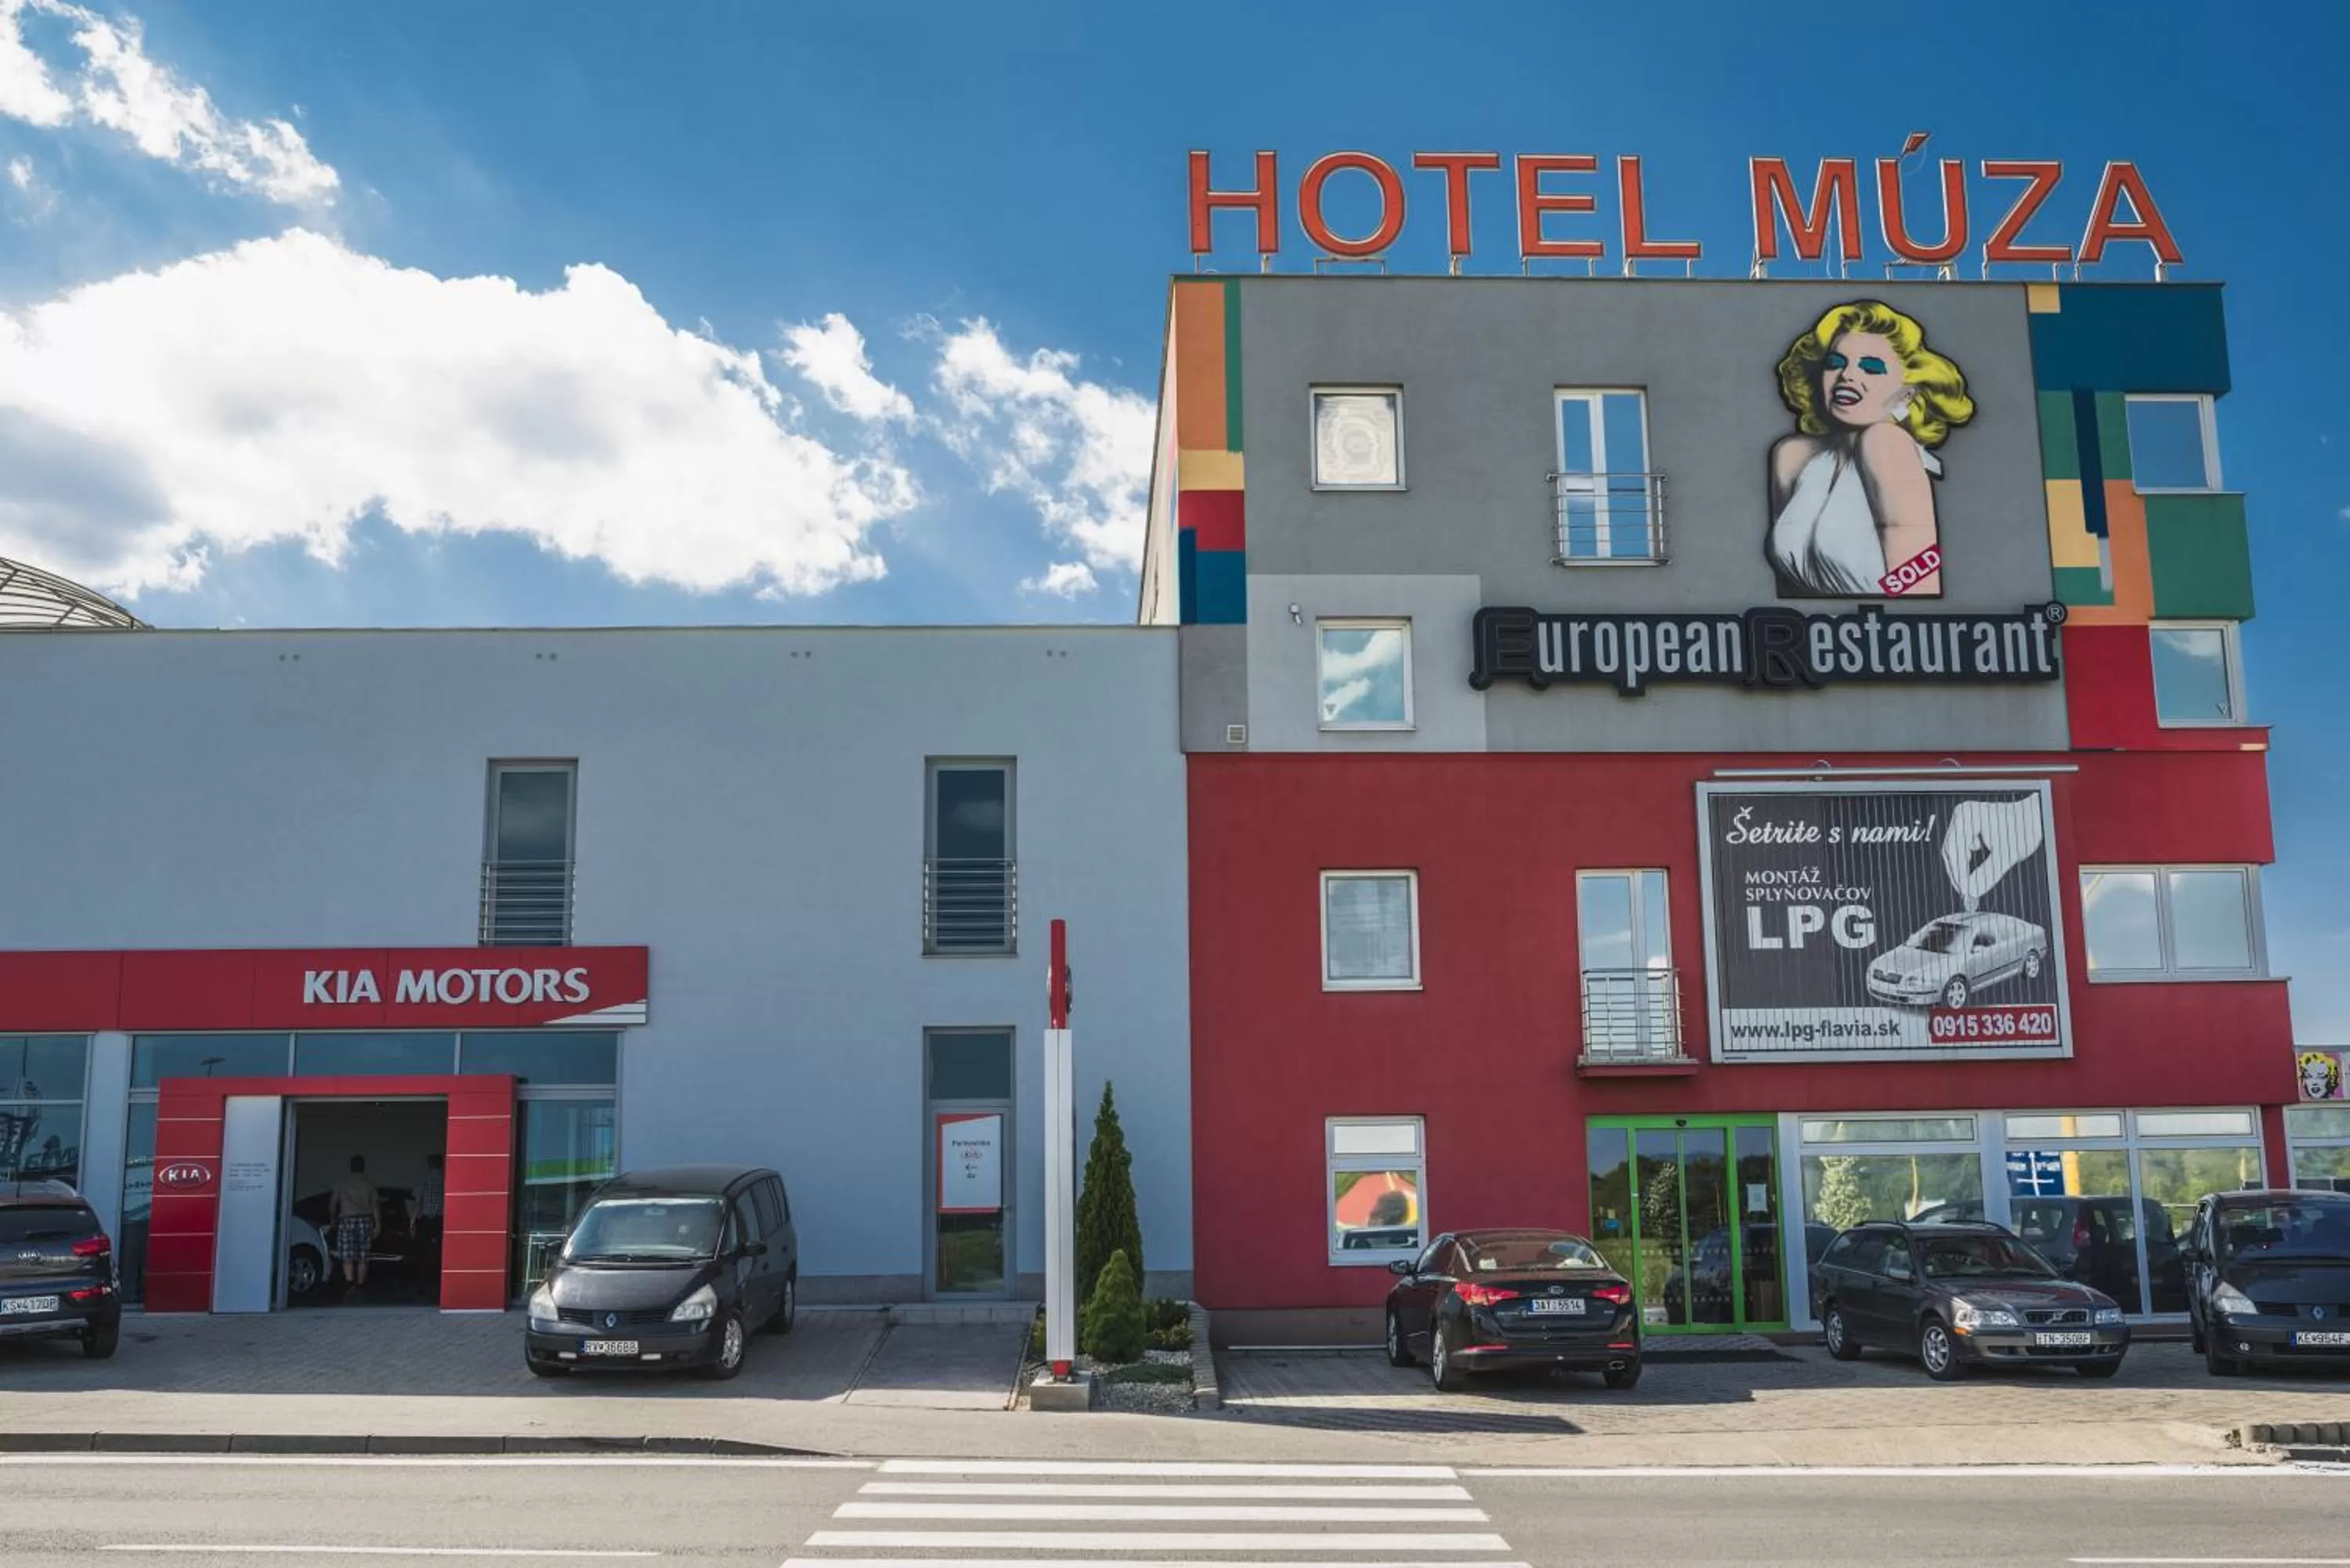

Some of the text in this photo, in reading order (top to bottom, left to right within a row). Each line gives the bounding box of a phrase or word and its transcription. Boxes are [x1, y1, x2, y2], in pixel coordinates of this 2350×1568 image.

[1188, 131, 2185, 264] HOTEL MÚZA
[1885, 551, 1940, 593] SOLD
[1473, 609, 1742, 689] European
[1726, 806, 1936, 845] Šetrite s nami!
[1744, 865, 1821, 884] MONTÁŽ
[1747, 905, 1877, 950] LPG
[303, 967, 591, 1005] KIA MOTORS
[1730, 1018, 1901, 1042] www.lpg-flavia.sk
[1932, 1013, 2052, 1038] 0915 336 420
[168, 1169, 201, 1183] KIA
